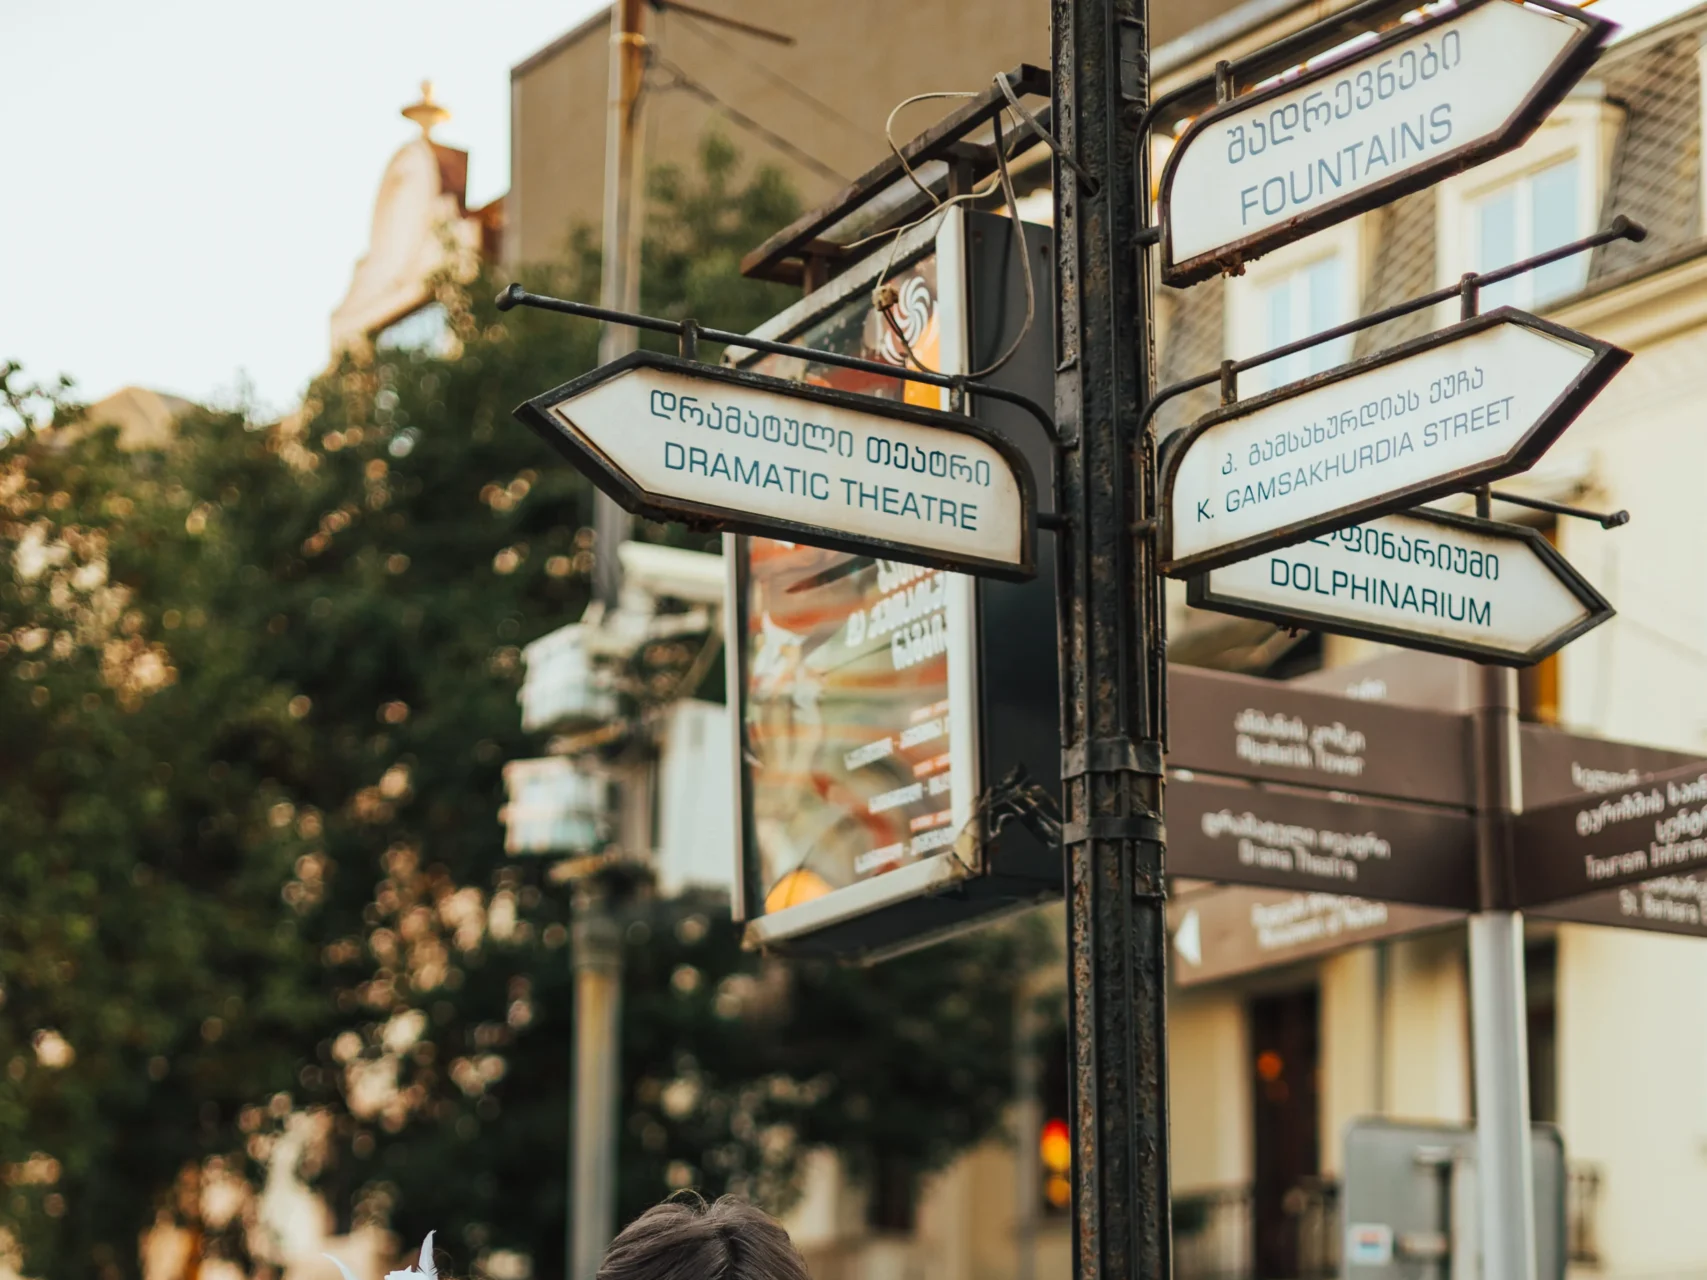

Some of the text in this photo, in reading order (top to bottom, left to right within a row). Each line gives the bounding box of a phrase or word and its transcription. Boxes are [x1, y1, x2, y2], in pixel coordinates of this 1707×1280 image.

[1227, 29, 1462, 164] შადრევნები
[1241, 103, 1454, 226] FOUNTAINS
[650, 389, 991, 487] დრამატული თეატრი
[1197, 396, 1515, 523] K. GAMSAKHURDIA STREET
[1249, 389, 1420, 466] გამსახურდიას
[1430, 366, 1485, 405] ქუჩა
[664, 441, 978, 531] DRAMATIC THEATRE
[1271, 558, 1491, 627] DOLPHINARIUM
[1309, 525, 1499, 581] ფინარიუმი
